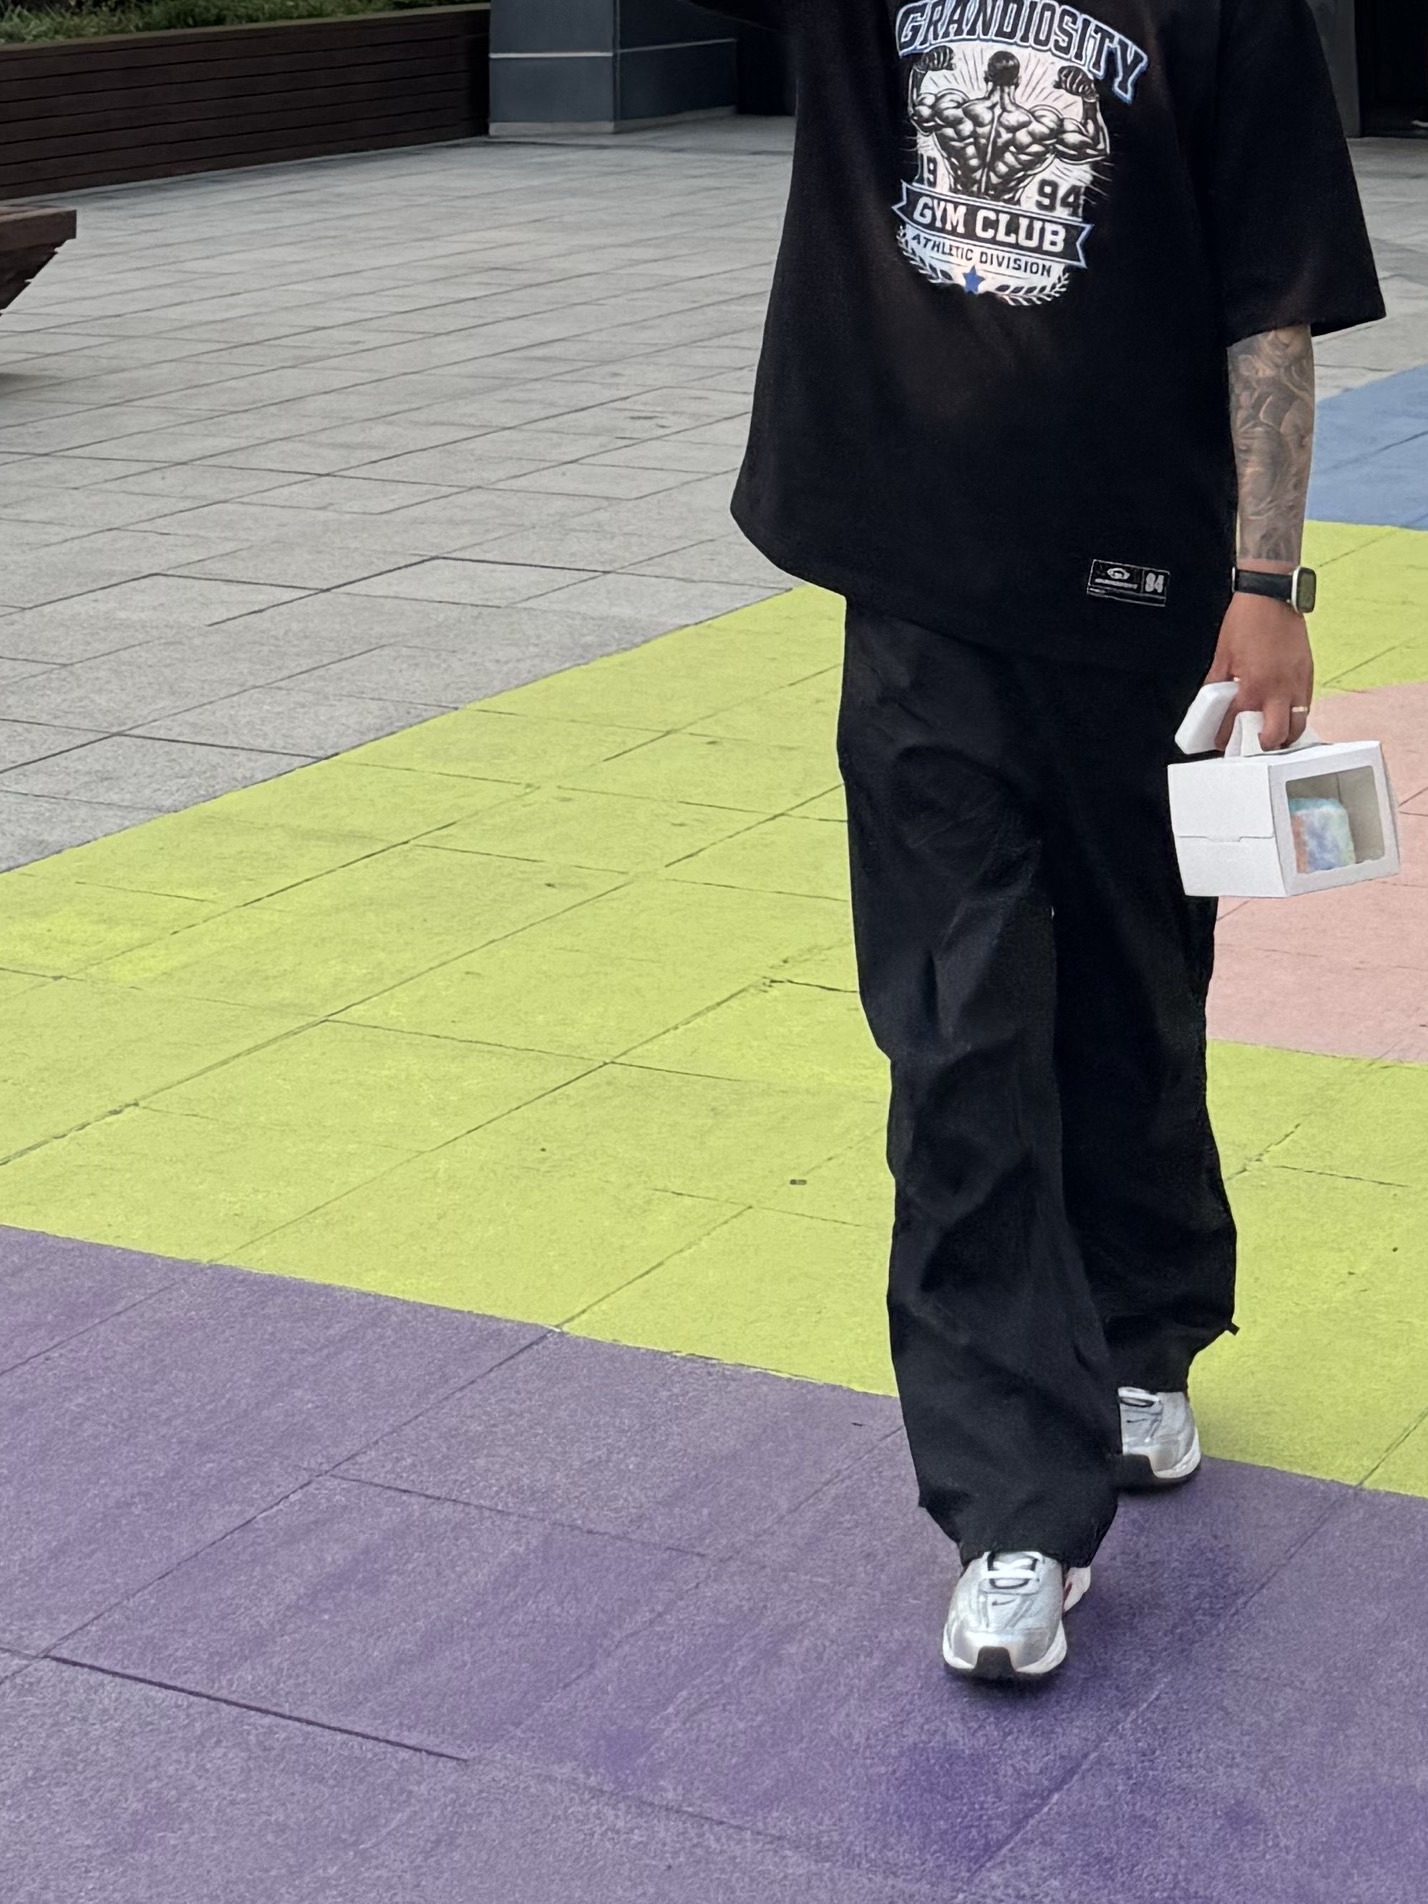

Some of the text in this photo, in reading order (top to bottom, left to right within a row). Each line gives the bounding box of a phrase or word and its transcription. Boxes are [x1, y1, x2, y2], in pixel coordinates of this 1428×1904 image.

[1036, 179, 1083, 219] 94
[913, 196, 1066, 253] GYM CLUB
[911, 233, 1053, 278] ATHLETIC DIVISION
